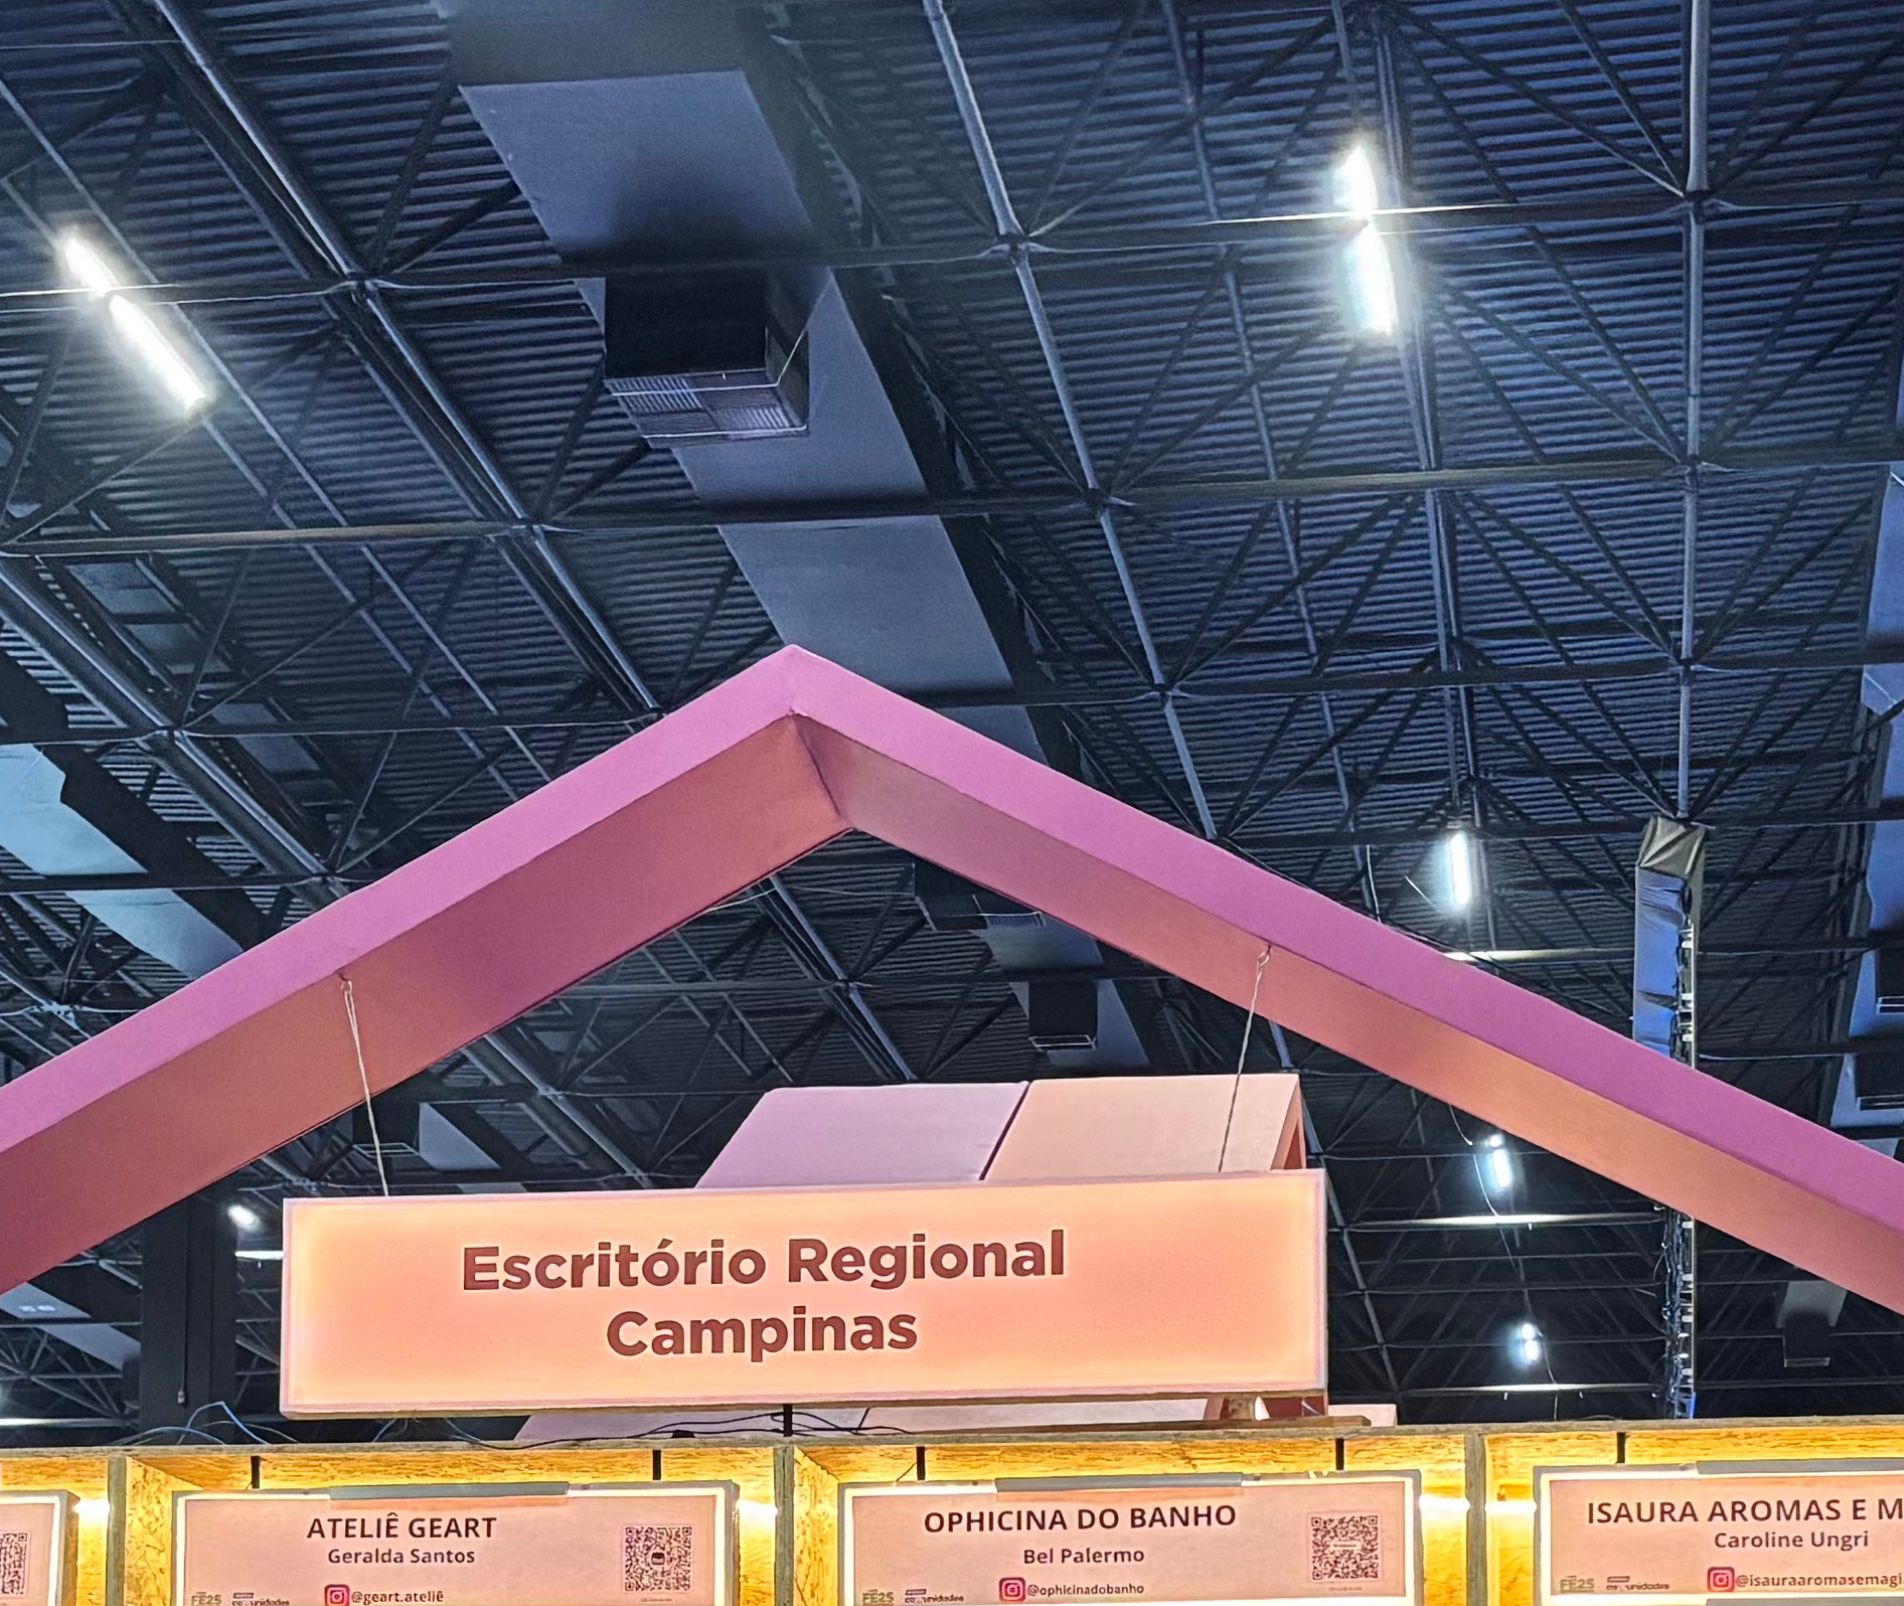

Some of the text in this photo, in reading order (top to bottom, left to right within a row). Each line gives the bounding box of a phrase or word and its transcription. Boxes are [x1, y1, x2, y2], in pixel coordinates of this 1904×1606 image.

[463, 1228, 1064, 1291] Escritório Regional
[606, 1305, 918, 1363] Campinas
[924, 1504, 1236, 1533] OPHICINA DO BANHO
[1588, 1500, 1699, 1524] ISAURA
[1707, 1498, 1841, 1522] AROMAS
[1852, 1498, 1867, 1521] E
[306, 1511, 497, 1539] ATELIÊ GEART
[1714, 1530, 1869, 1552] Caroline Ungri
[327, 1547, 475, 1564] Geralda Santos
[1023, 1547, 1145, 1565] Bel Palermo
[1026, 1583, 1145, 1598] @ophicinadobanho
